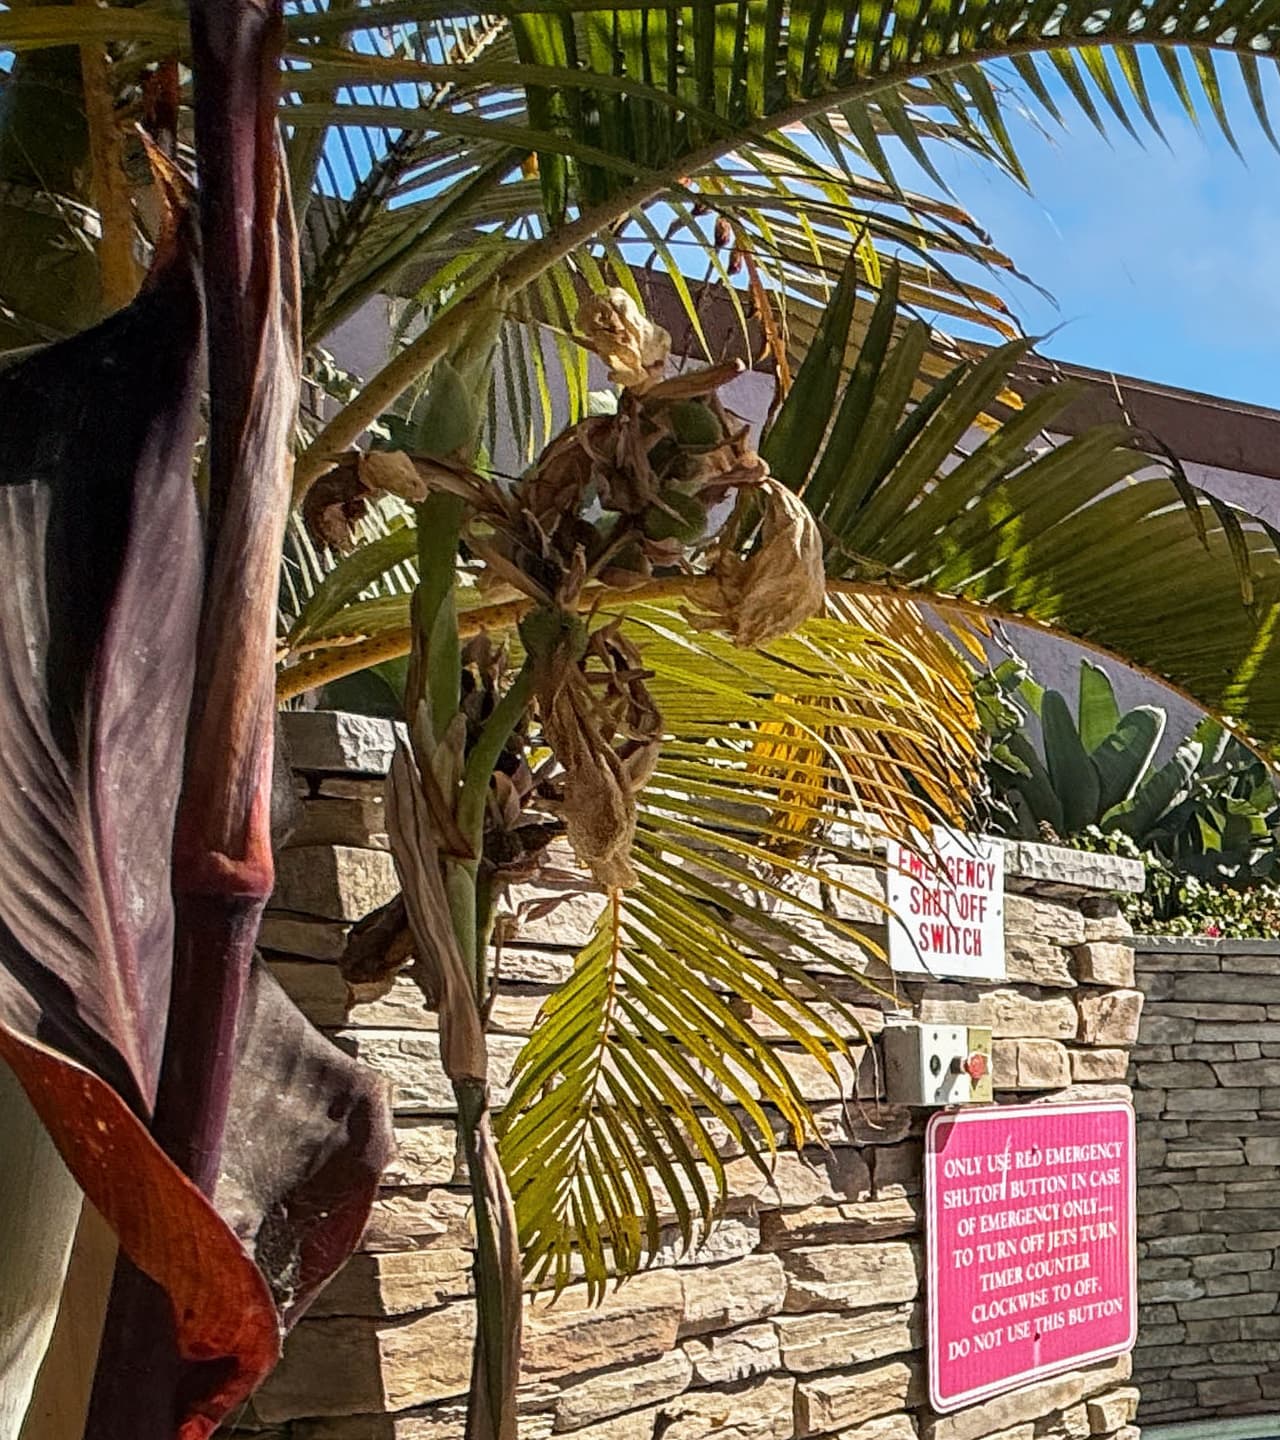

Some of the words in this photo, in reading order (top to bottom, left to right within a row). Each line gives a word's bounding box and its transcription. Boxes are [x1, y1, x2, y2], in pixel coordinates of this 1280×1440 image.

[959, 892, 987, 923] OFF
[919, 922, 981, 957] SWITCH
[944, 1156, 984, 1179] ONLY
[987, 1153, 1012, 1173] USE
[1015, 1149, 1042, 1169] RED
[1046, 1142, 1123, 1166] EMERGENCY
[1010, 1175, 1067, 1199] BUTTON
[1071, 1171, 1087, 1190] IN
[1090, 1168, 1120, 1188] CASE
[957, 1217, 976, 1237] OF
[980, 1204, 1060, 1234] EMERGENCY
[953, 1248, 973, 1269] TO
[977, 1239, 1017, 1264] TURN
[1020, 1233, 1045, 1255] OFF
[1047, 1228, 1077, 1253] JETS
[1080, 1222, 1118, 1244] TURN
[980, 1266, 1023, 1293] TIMER
[1025, 1253, 1091, 1282] COUNTER
[971, 1288, 1048, 1324] CLOCKWISE
[1052, 1283, 1071, 1303] TO
[1074, 1277, 1102, 1298] OFF.
[948, 1338, 970, 1361] DO
[974, 1328, 1003, 1353] NOT
[1007, 1320, 1031, 1343] USE
[1034, 1312, 1065, 1335] THIS
[1067, 1297, 1124, 1326] BUTTON
